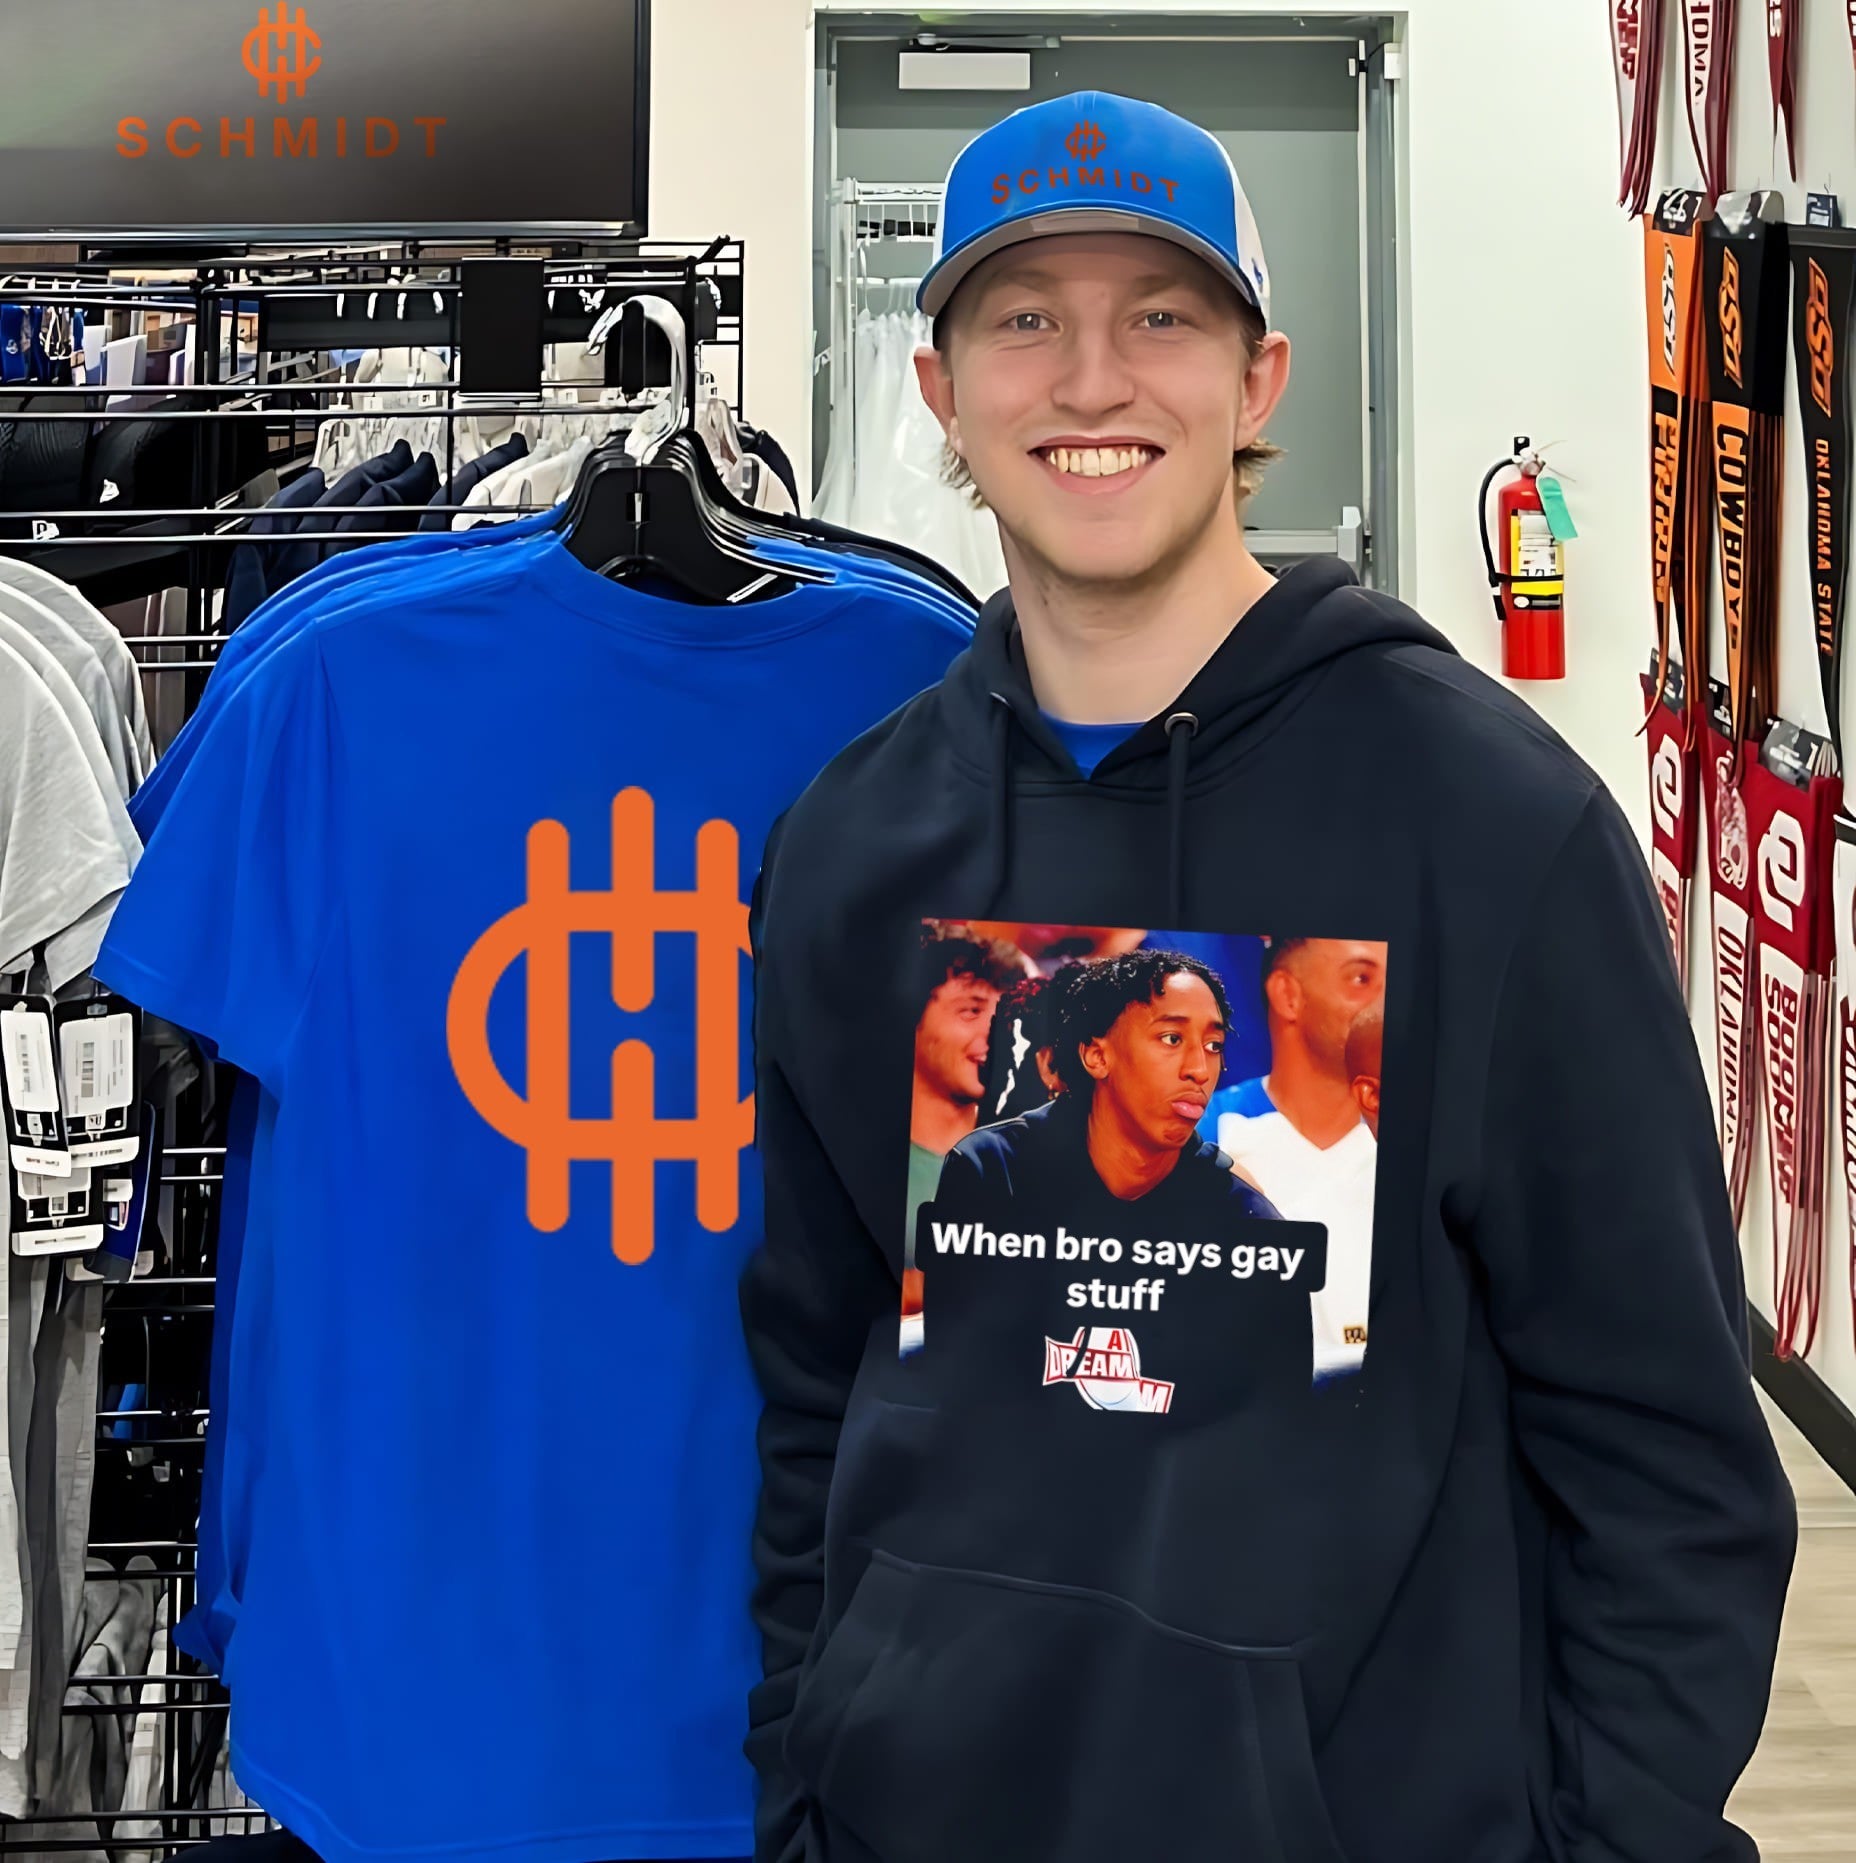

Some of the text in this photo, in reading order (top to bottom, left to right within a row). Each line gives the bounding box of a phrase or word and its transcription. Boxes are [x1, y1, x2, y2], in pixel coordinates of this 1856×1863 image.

[115, 116, 448, 159] SCHMIDT
[991, 166, 1179, 205] SCHMIDT
[1815, 438, 1832, 570] OKLAHOMA
[931, 1222, 1305, 1281] When bro says gay
[1066, 1279, 1165, 1311] stuff
